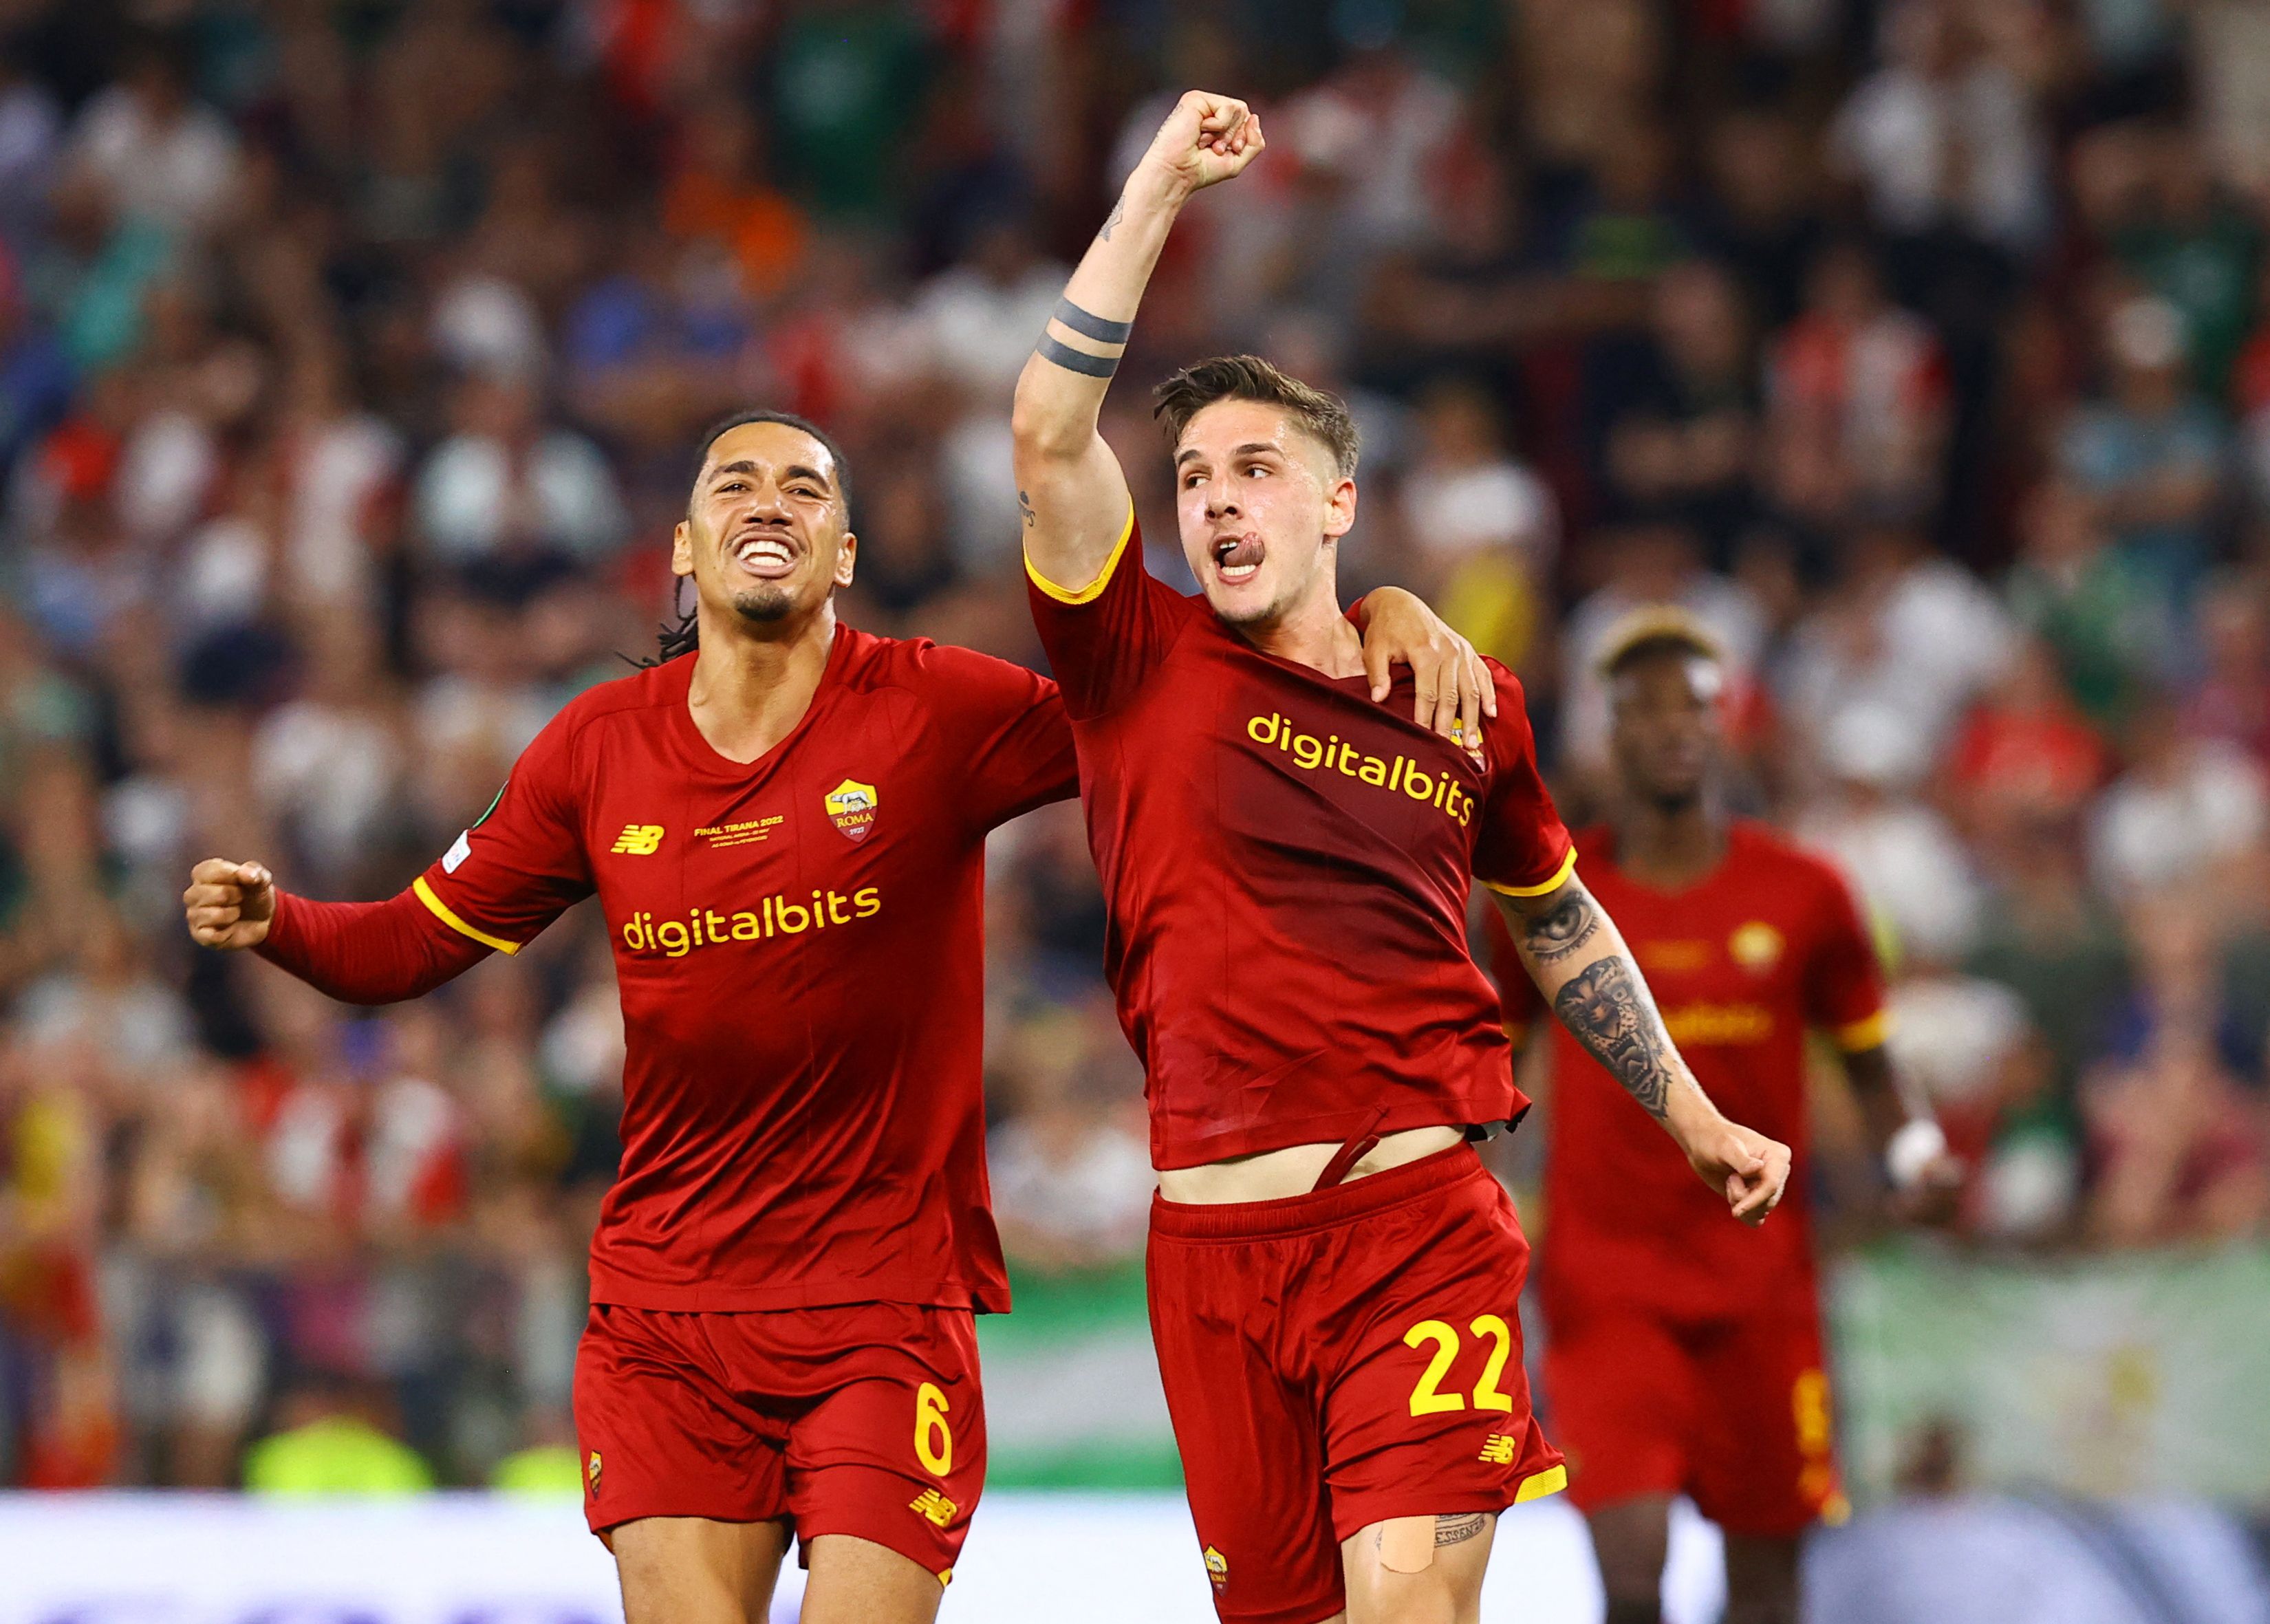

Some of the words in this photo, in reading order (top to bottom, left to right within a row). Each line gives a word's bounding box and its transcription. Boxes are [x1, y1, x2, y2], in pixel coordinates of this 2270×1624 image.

[1247, 712, 1475, 827] digitalbits
[694, 827, 723, 836] FINAL
[724, 821, 759, 832] TIRANA
[760, 815, 783, 826] 2022
[836, 813, 874, 827] ROMA
[623, 887, 881, 957] digitalbits
[1403, 1314, 1513, 1417] 22
[914, 1382, 953, 1477] 6
